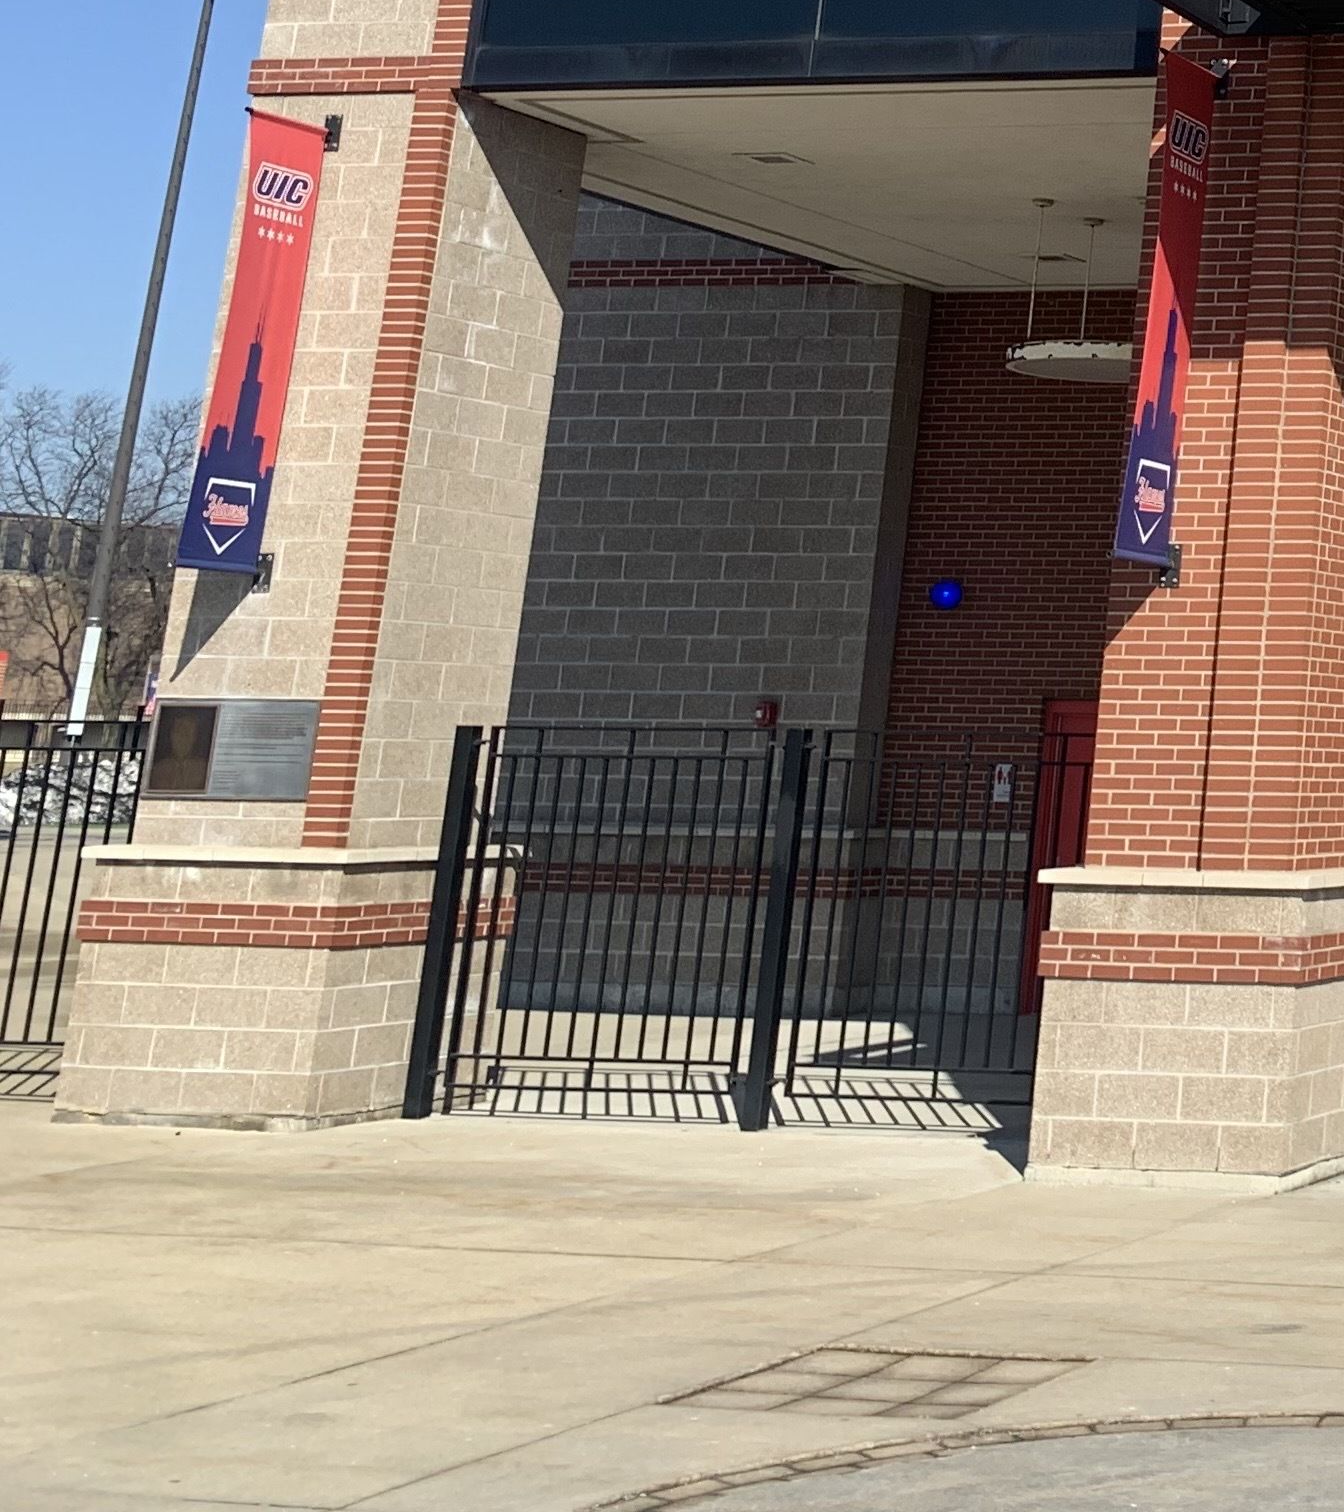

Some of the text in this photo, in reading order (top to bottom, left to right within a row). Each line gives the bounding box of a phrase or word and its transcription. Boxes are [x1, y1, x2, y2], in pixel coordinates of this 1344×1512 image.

[1170, 113, 1208, 161] UIC
[254, 164, 312, 208] UIC
[1170, 155, 1204, 183] BASEBALL
[253, 203, 304, 228] BASEBALL
